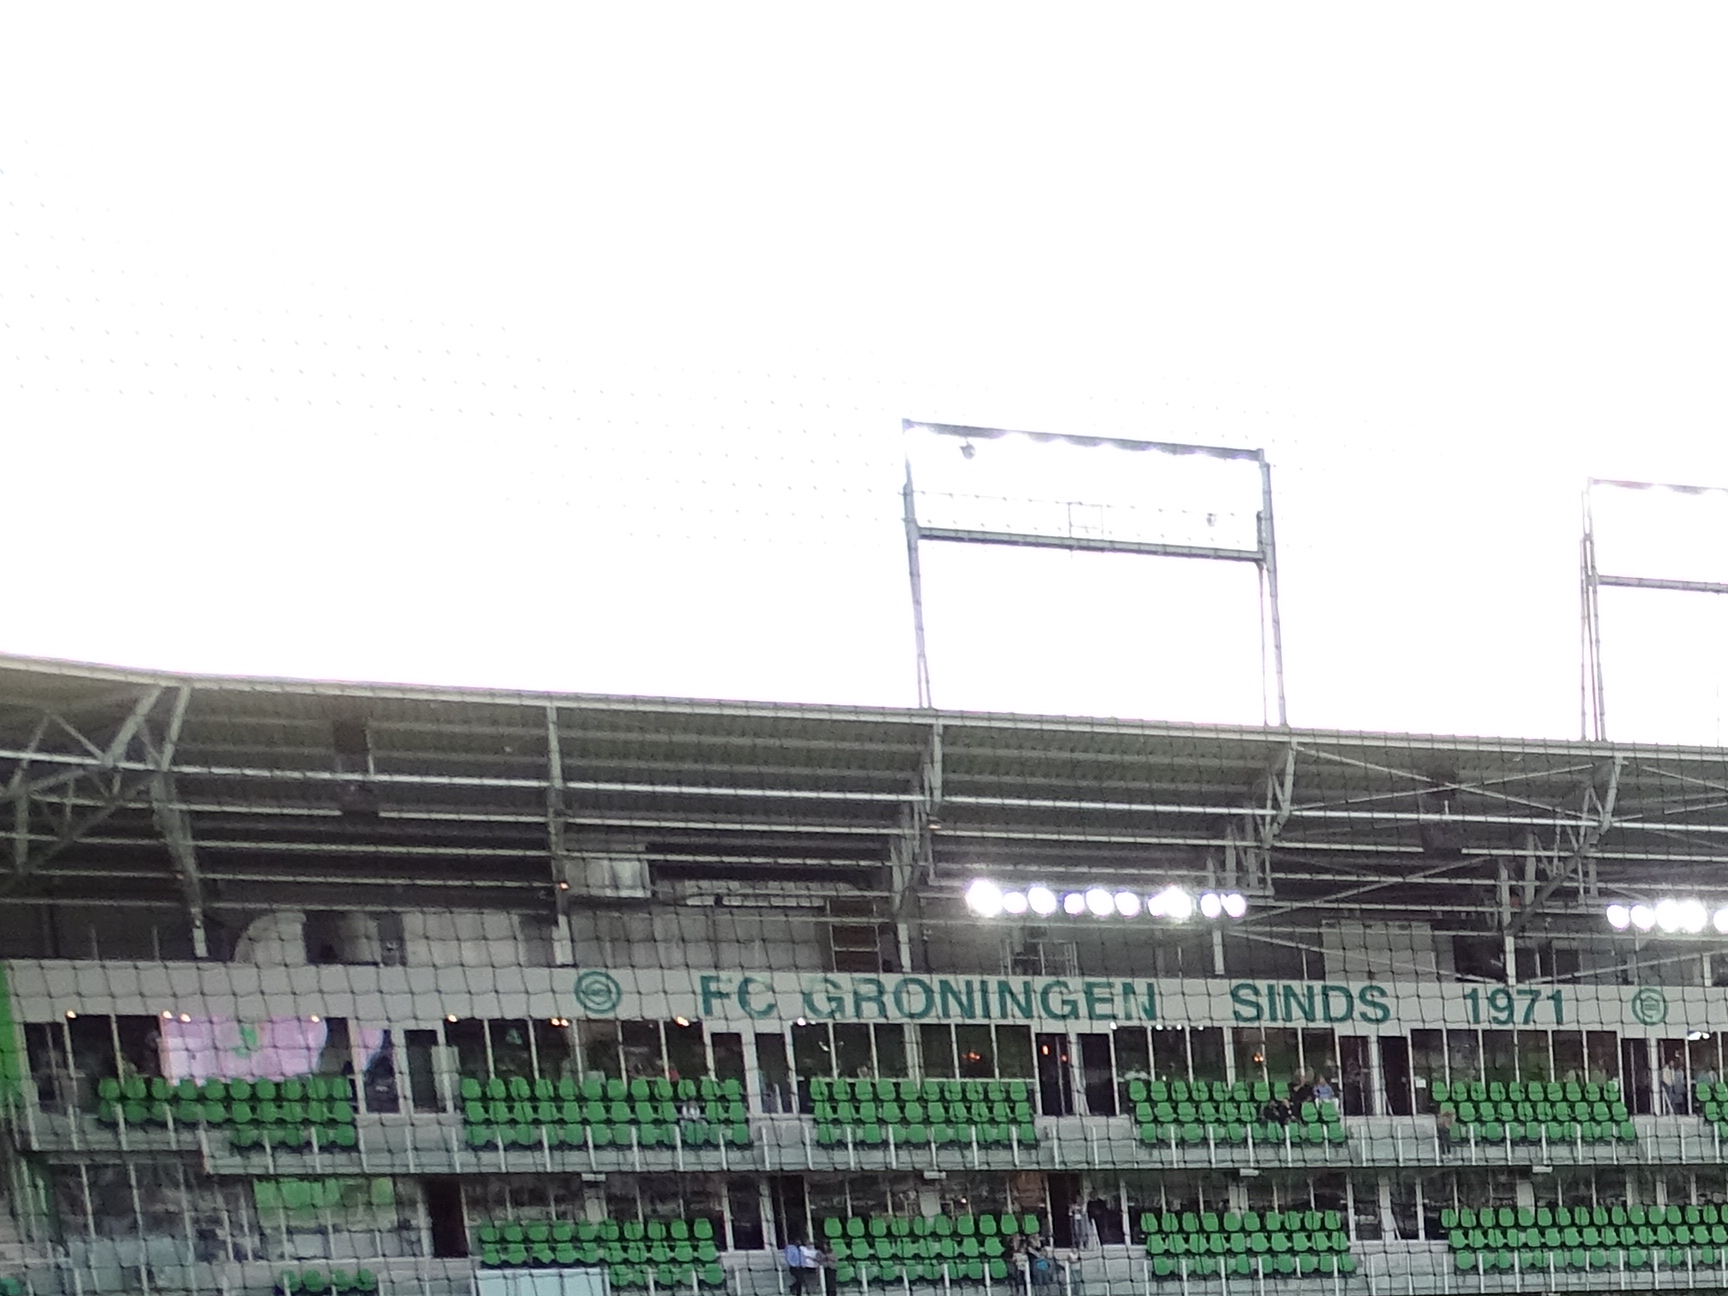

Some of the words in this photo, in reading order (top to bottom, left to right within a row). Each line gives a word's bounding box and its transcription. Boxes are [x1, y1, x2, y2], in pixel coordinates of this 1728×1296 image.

[700, 975, 776, 1016] FC
[803, 976, 1156, 1021] GRONINGEN
[1232, 982, 1392, 1024] SINDS
[1464, 987, 1564, 1026] 1971
